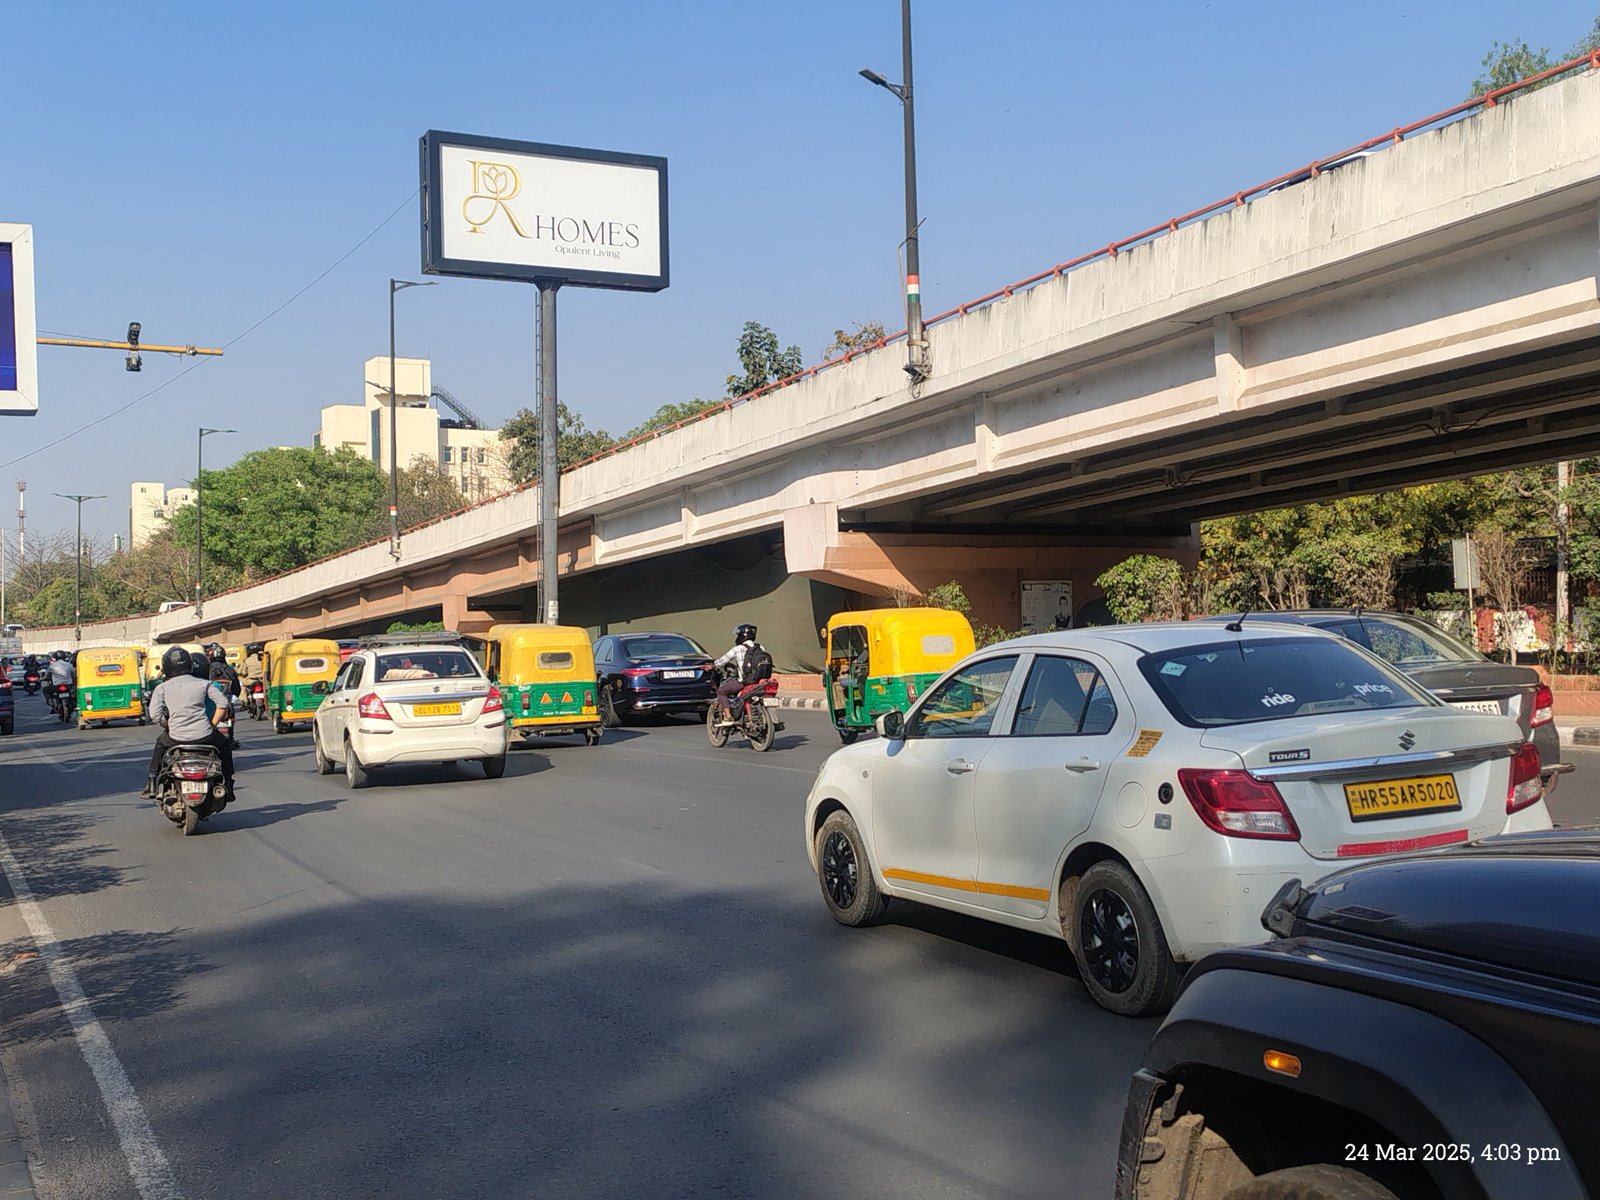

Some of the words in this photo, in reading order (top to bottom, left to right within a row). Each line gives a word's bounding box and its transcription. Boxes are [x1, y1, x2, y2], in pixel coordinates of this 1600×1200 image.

[536, 215, 639, 248] HOMES
[555, 245, 590, 256] Opulent
[592, 247, 620, 259] Living
[1353, 682, 1393, 696] price
[1260, 693, 1296, 707] ride
[1271, 752, 1298, 760] TOUR
[1298, 750, 1308, 759] S
[1358, 781, 1454, 809] HR55AR5020
